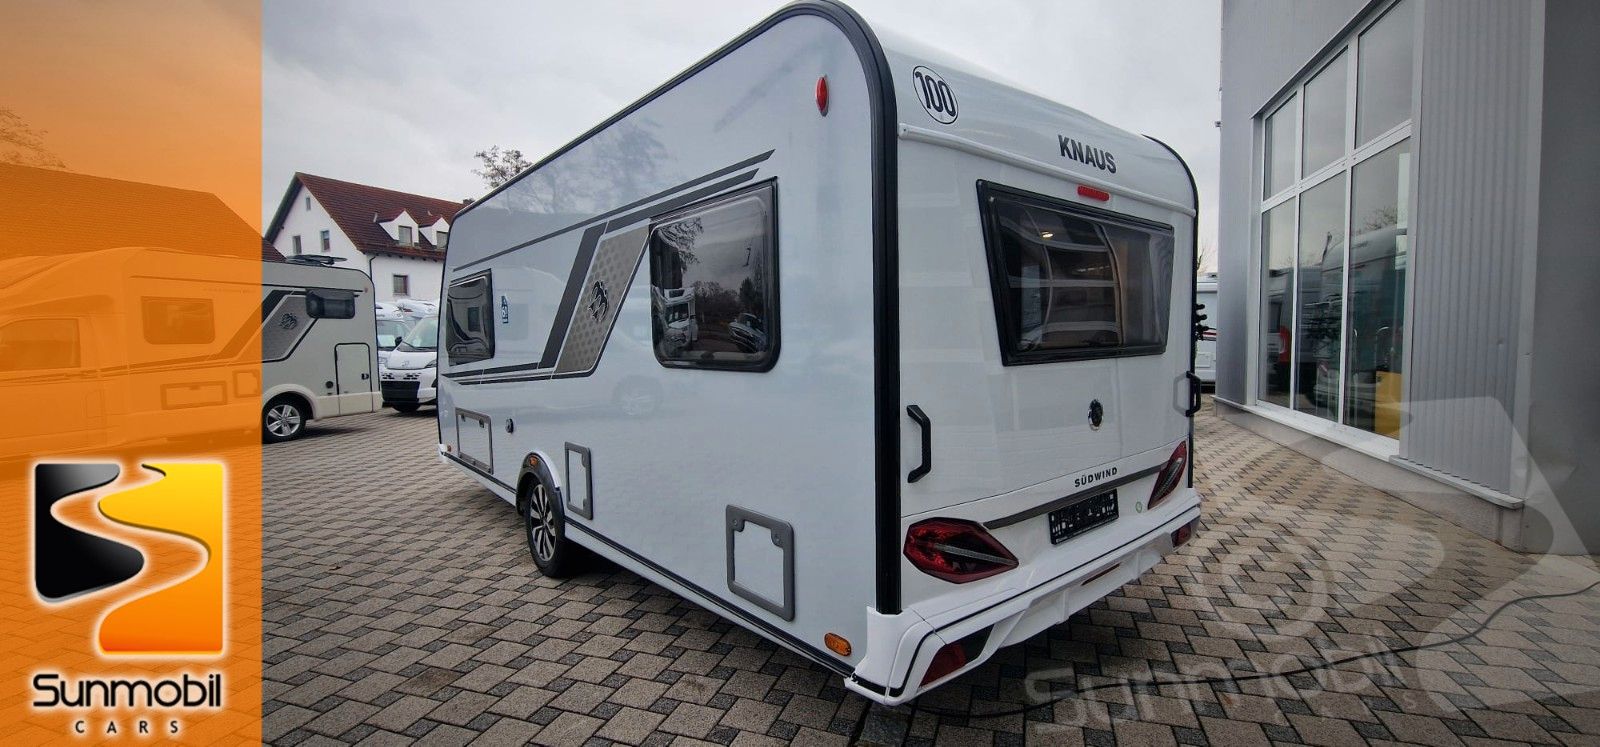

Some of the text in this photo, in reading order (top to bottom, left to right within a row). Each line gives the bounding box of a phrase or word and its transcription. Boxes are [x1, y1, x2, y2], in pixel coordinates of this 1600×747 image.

[914, 70, 957, 118] 100
[1057, 134, 1117, 174] KNAUS
[1074, 466, 1118, 488] SÜDWIND
